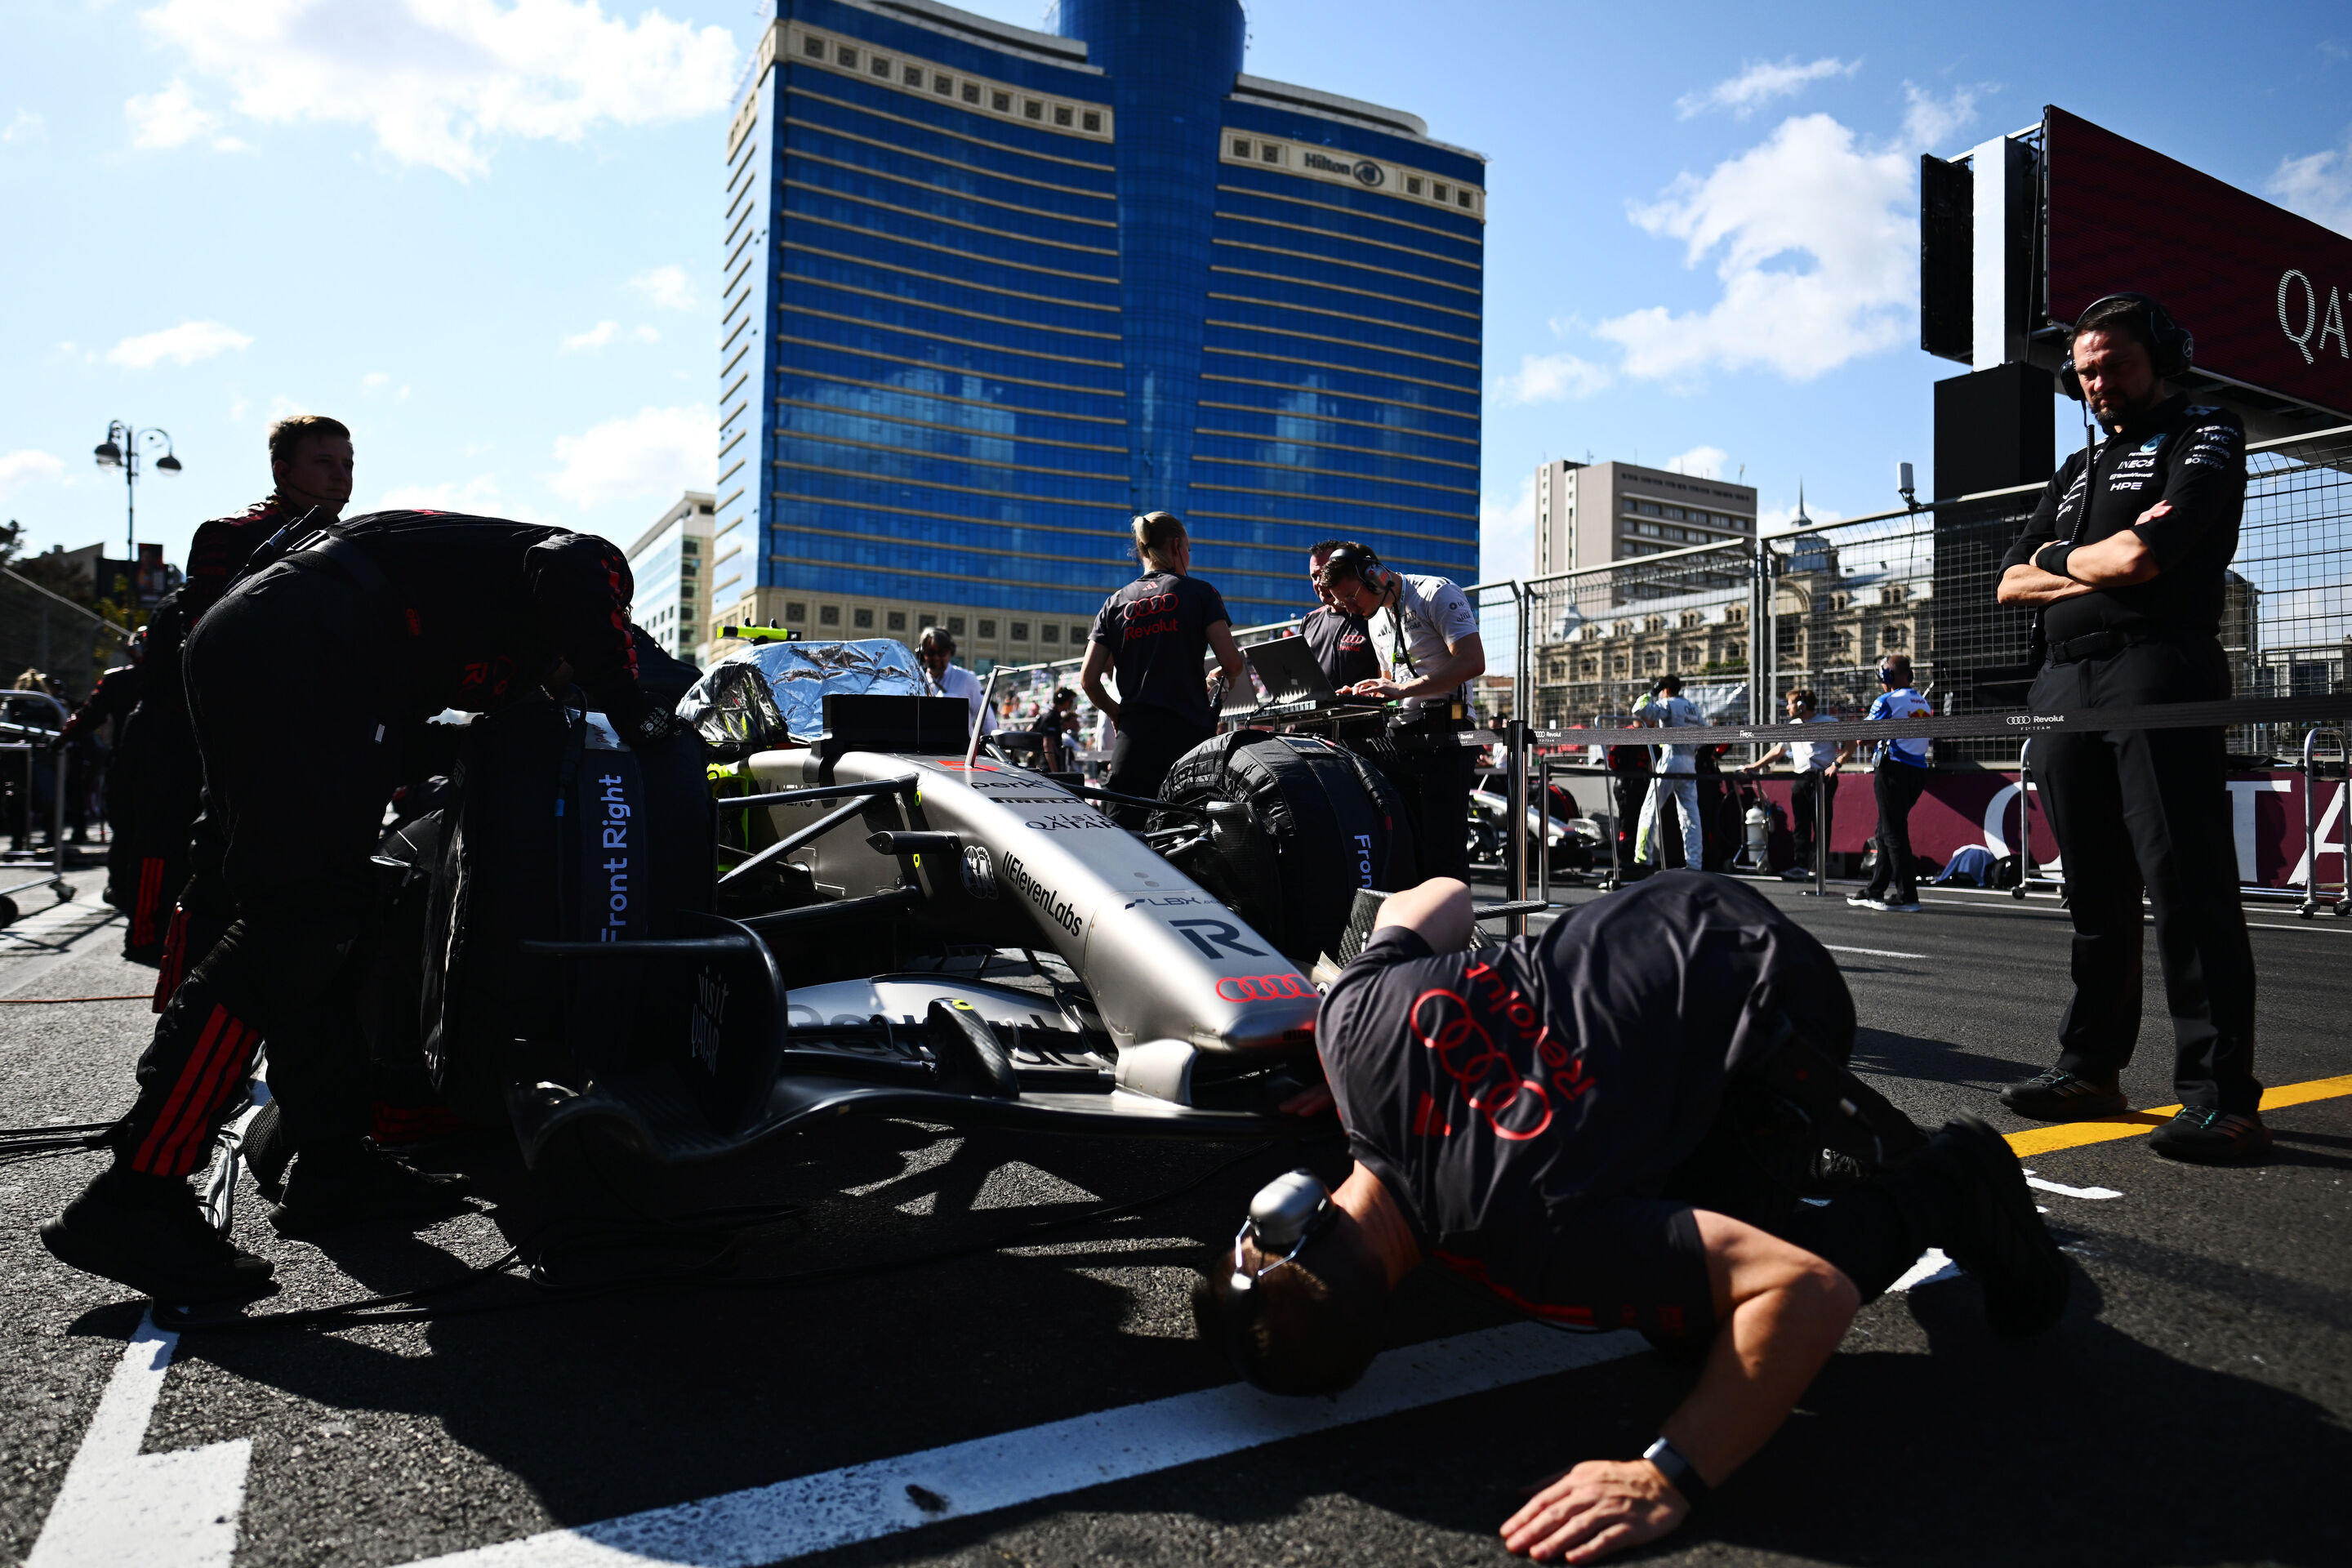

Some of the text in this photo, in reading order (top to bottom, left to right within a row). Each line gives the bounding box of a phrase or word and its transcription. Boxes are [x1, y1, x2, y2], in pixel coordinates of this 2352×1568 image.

[1304, 152, 1350, 175] Hilton
[2278, 269, 2352, 364] QA
[2109, 482, 2143, 491] HPE
[2117, 458, 2155, 470] INEOS
[1125, 617, 1179, 641] Revolut
[2033, 715, 2065, 723] Revolut
[598, 774, 631, 849] Right
[1025, 821, 1124, 831] QATAR
[1354, 835, 1372, 889] Fron
[600, 858, 628, 942] Front
[1169, 919, 1270, 960] R
[699, 965, 729, 1024] visit
[692, 1003, 719, 1077] QATAR
[1464, 961, 1597, 1102] Revolut
